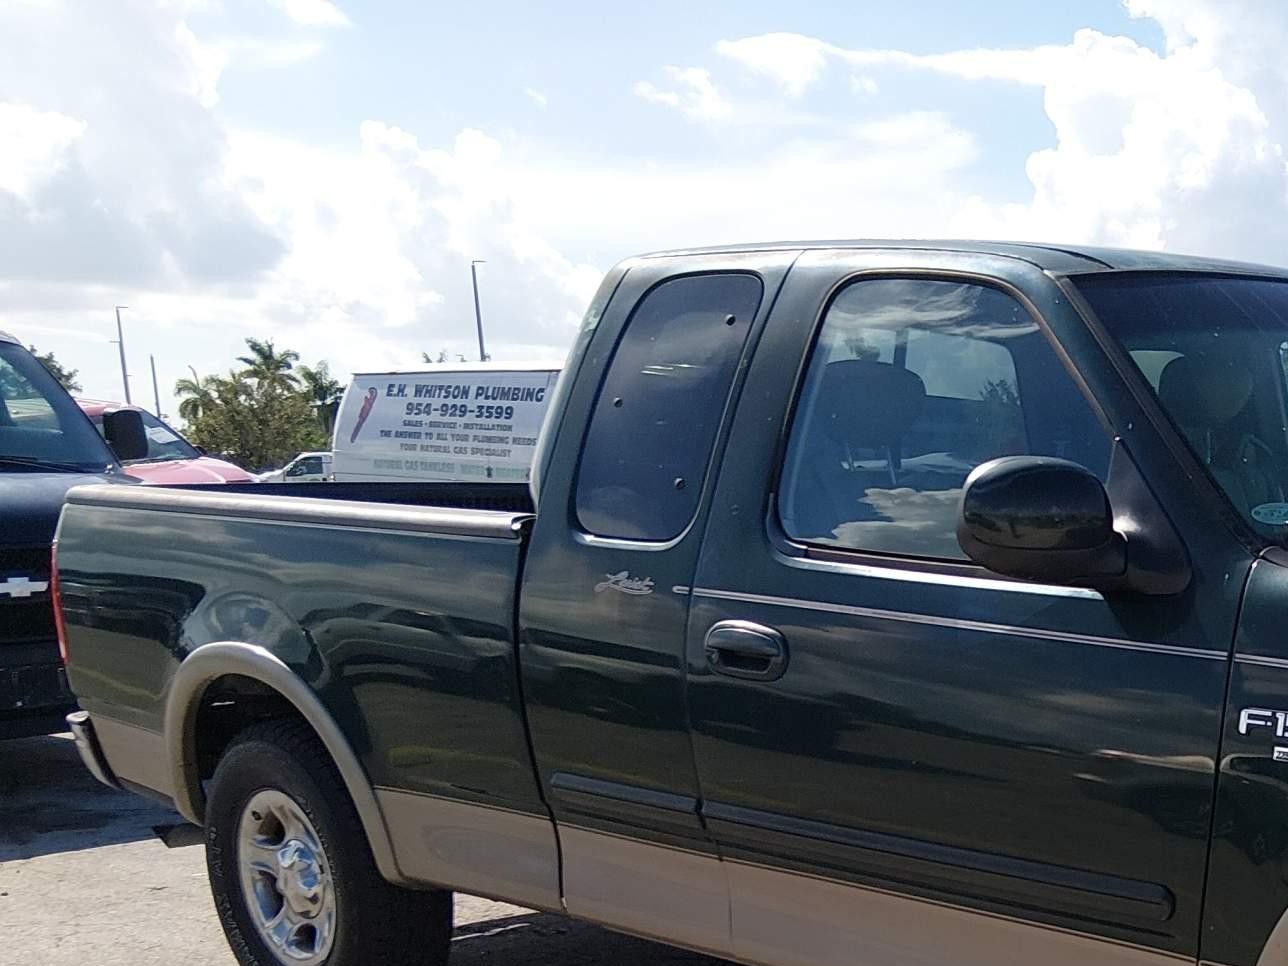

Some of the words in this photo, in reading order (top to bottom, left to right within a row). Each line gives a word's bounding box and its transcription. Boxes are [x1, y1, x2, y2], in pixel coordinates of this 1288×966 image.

[414, 384, 470, 400] WHITSON
[475, 386, 545, 402] PLUMBING
[405, 402, 514, 420] 954-929-3599
[462, 422, 513, 432] INSTALLATION
[380, 430, 392, 438] THE
[425, 432, 433, 440] TO
[451, 433, 470, 442] YOUR
[512, 437, 537, 446] NEEDS
[453, 446, 468, 455] GAS
[471, 447, 512, 457] SPECIALIST
